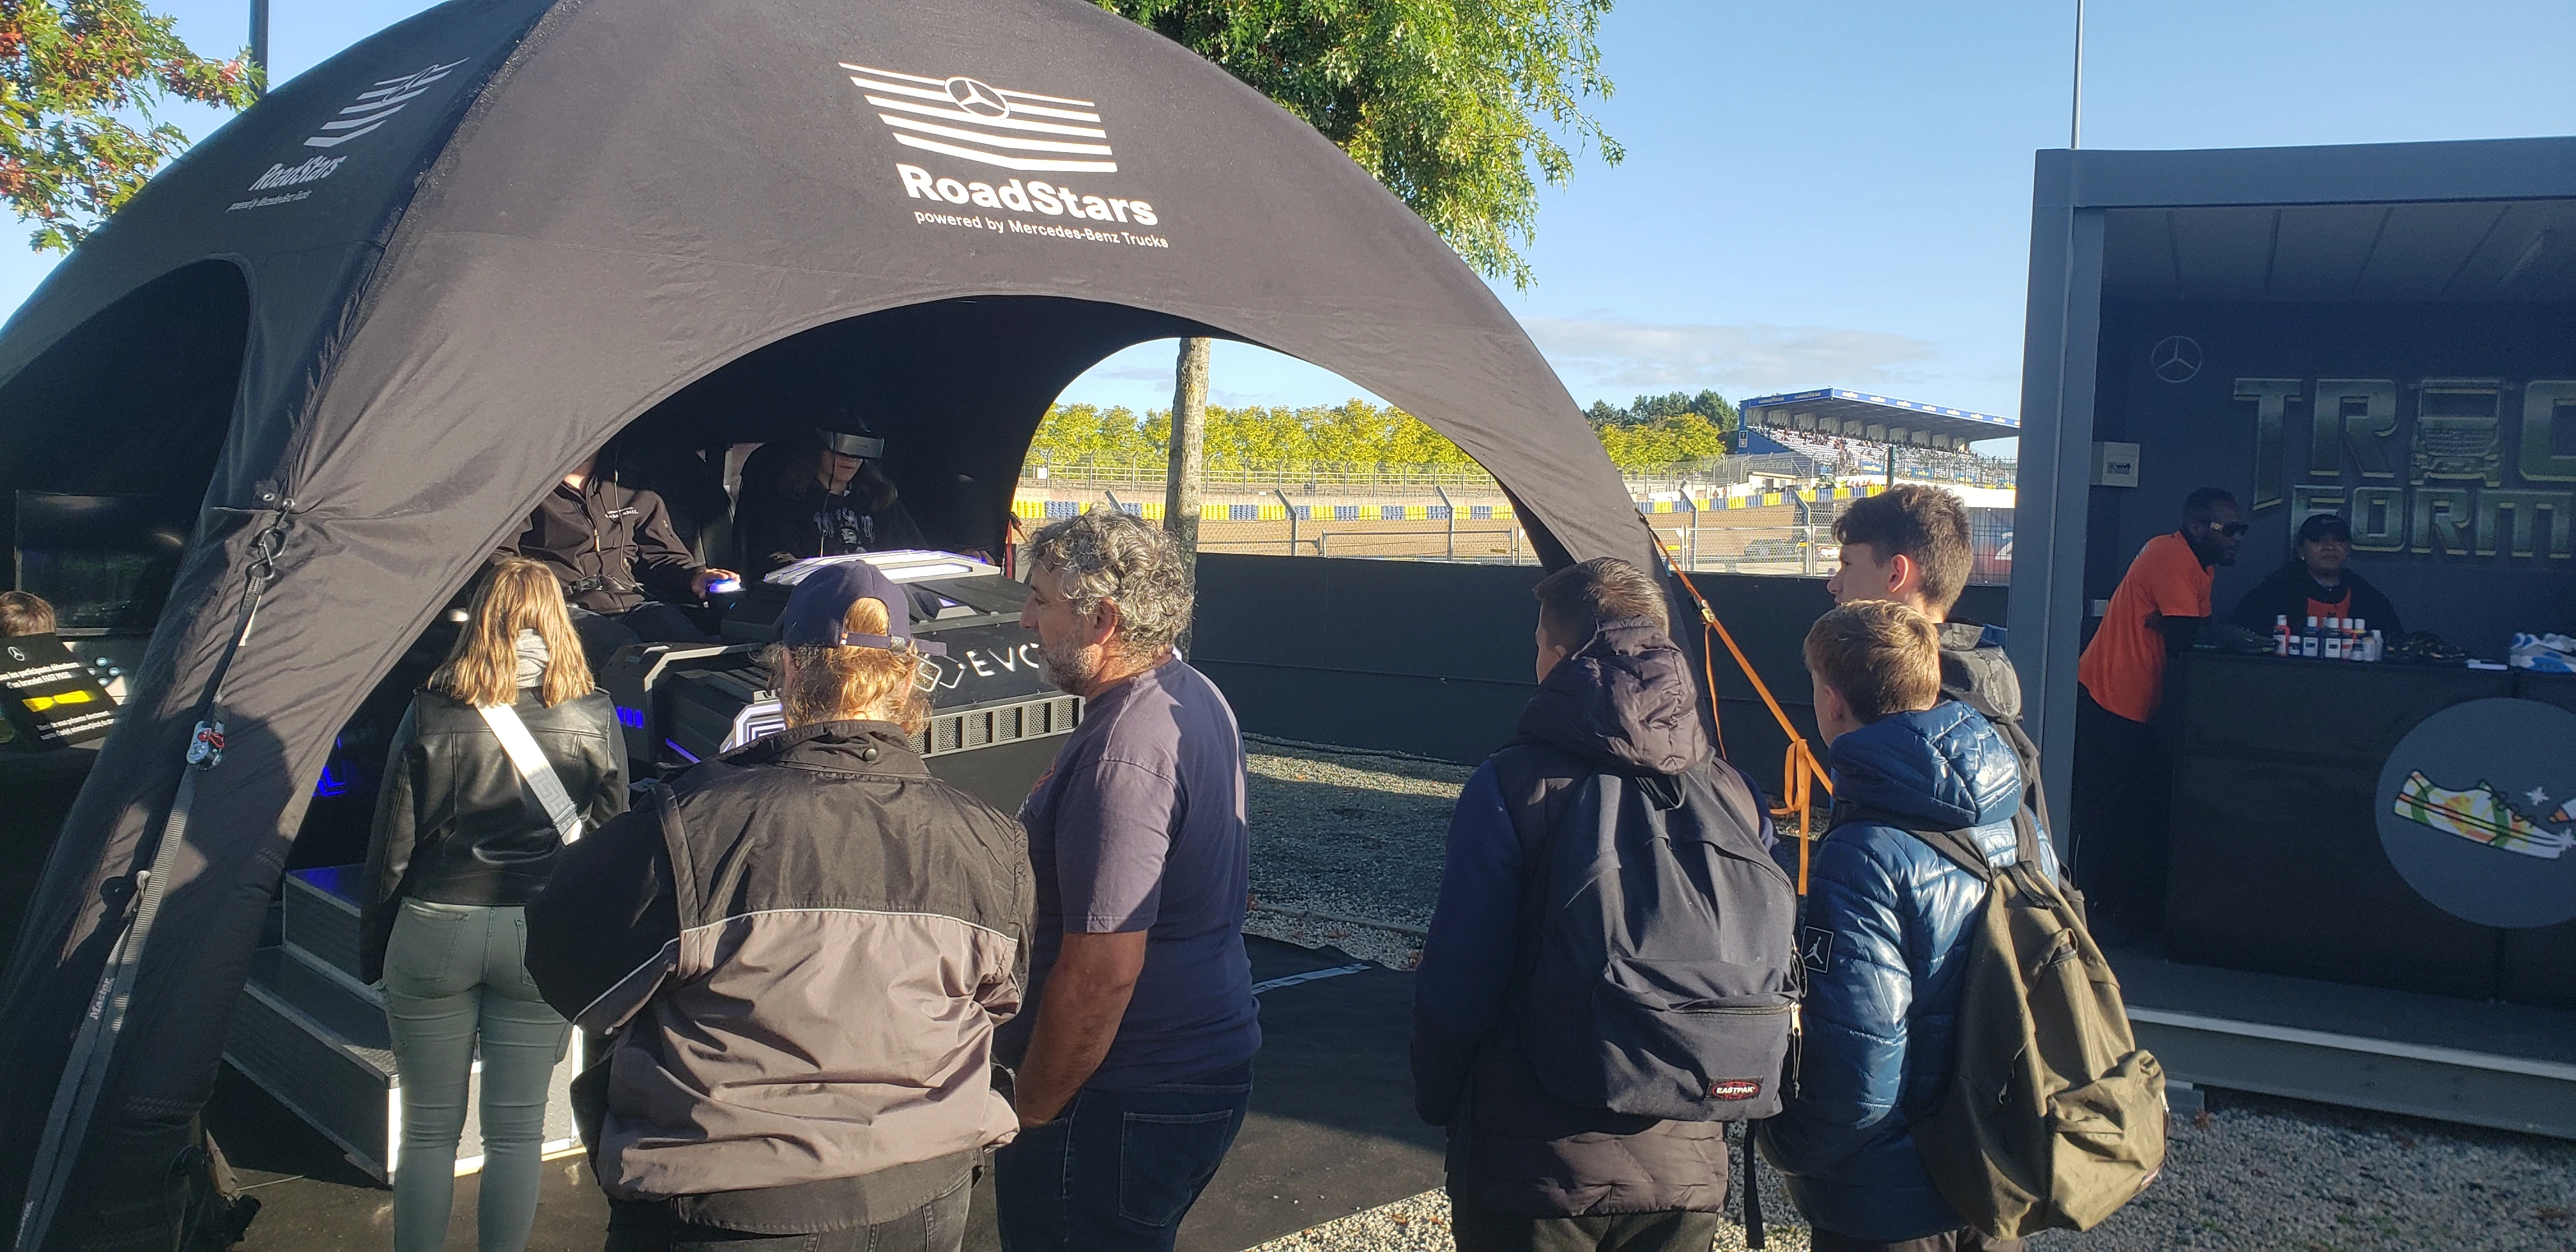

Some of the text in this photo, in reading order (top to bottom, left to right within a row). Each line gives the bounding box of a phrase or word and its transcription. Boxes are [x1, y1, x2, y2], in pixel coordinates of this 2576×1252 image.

[248, 156, 348, 191] RoadStars
[896, 163, 1158, 226] RoadStars
[914, 210, 1169, 248] powered by Mercedes-Benz Trucks
[17, 677, 45, 687] bracelet
[41, 674, 58, 683] FAST
[54, 671, 72, 680] PASS
[1716, 1086, 1754, 1095] EASTPAK
